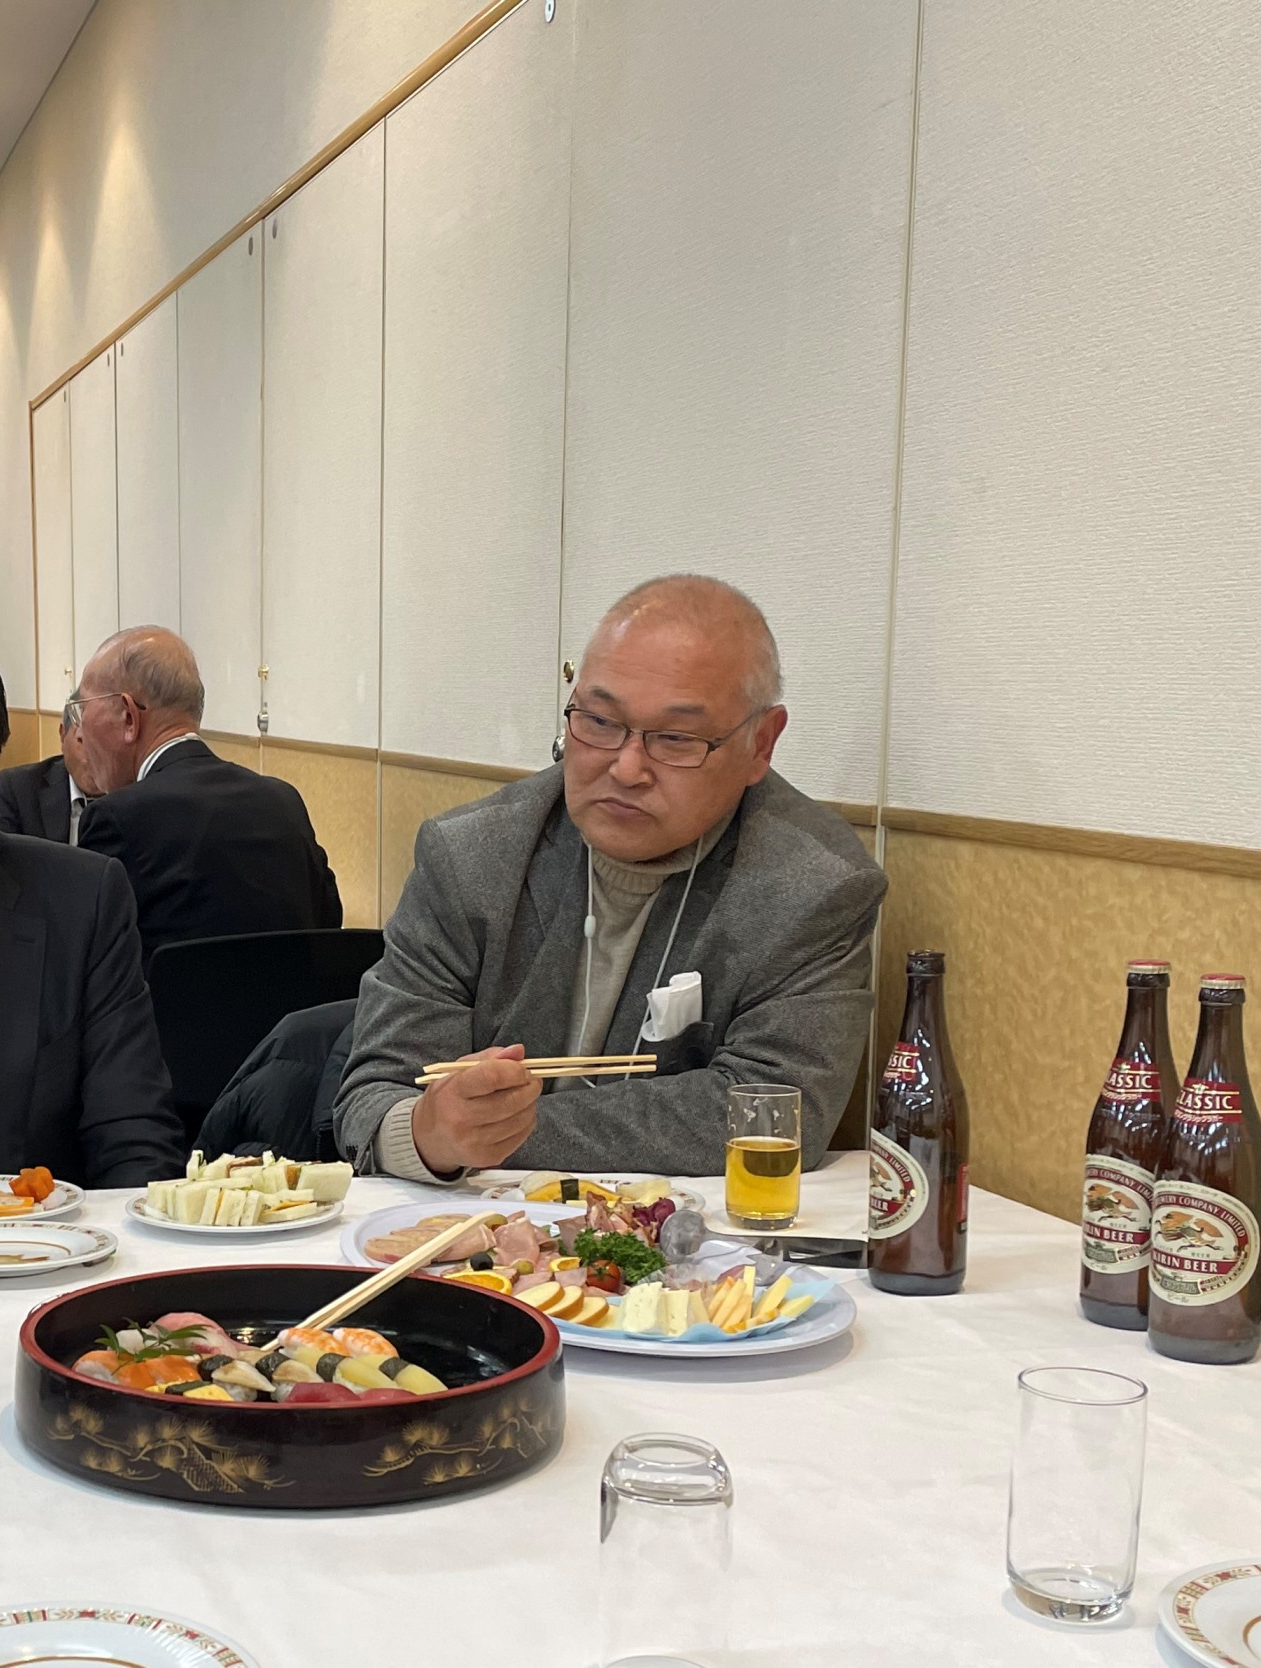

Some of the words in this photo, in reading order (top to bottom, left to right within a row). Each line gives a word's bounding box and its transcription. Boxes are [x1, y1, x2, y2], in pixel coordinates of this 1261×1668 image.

[1220, 1210, 1246, 1237] LIMITED
[1103, 1229, 1134, 1243] BEER
[1152, 1250, 1180, 1268] KIRIN
[1184, 1259, 1218, 1273] BEER
